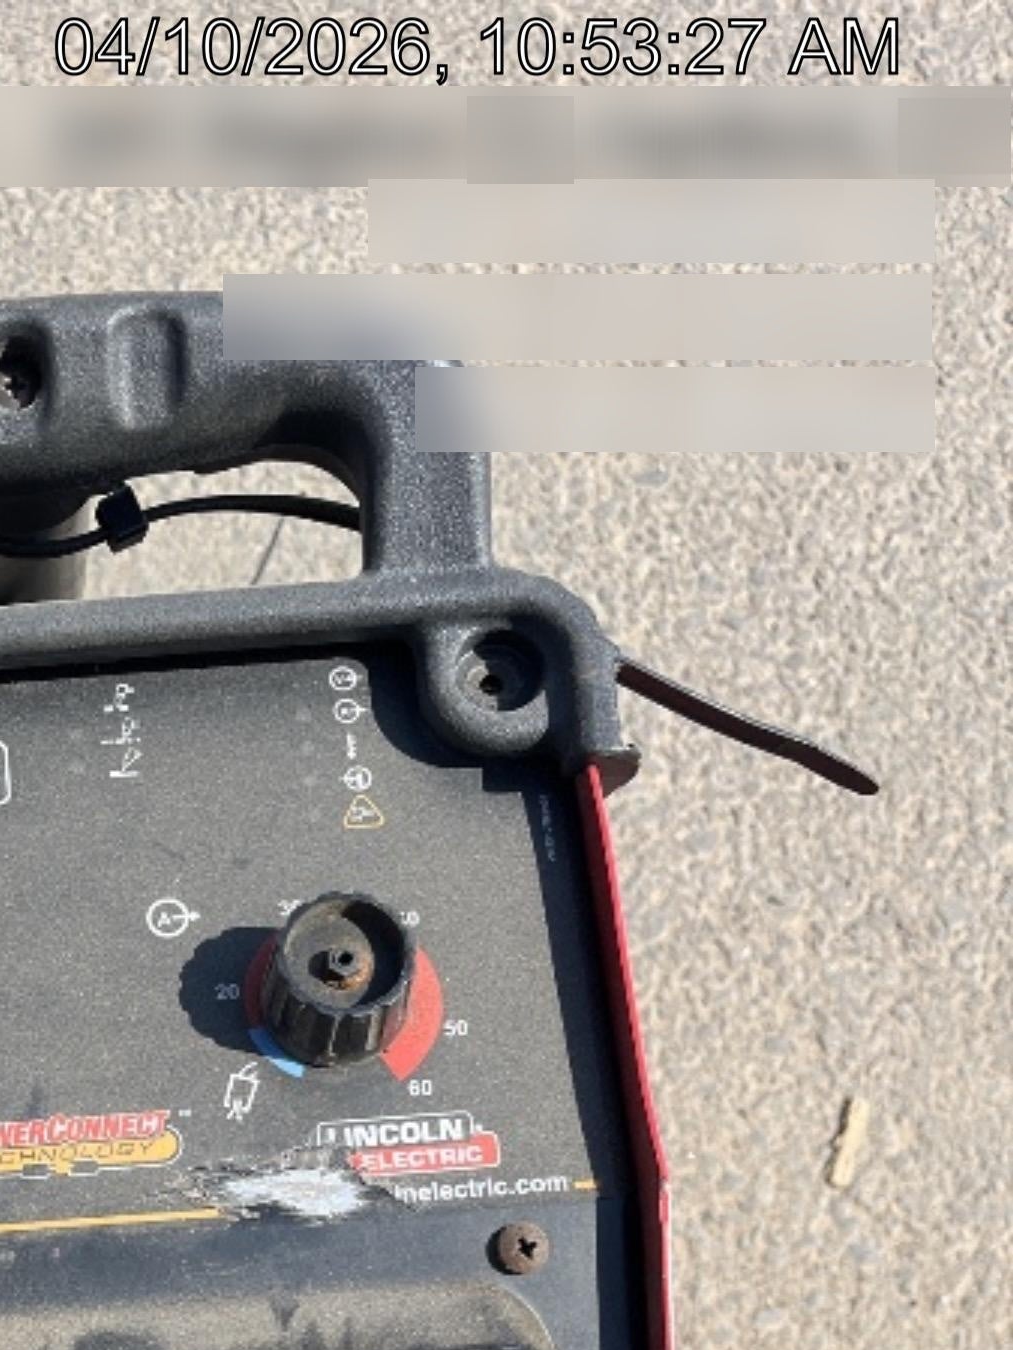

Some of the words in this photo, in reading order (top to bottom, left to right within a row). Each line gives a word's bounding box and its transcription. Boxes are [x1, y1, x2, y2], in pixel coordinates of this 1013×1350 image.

[215, 983, 239, 1000] 20
[444, 1020, 468, 1036] 50
[361, 1145, 484, 1171] ELECTRIC
